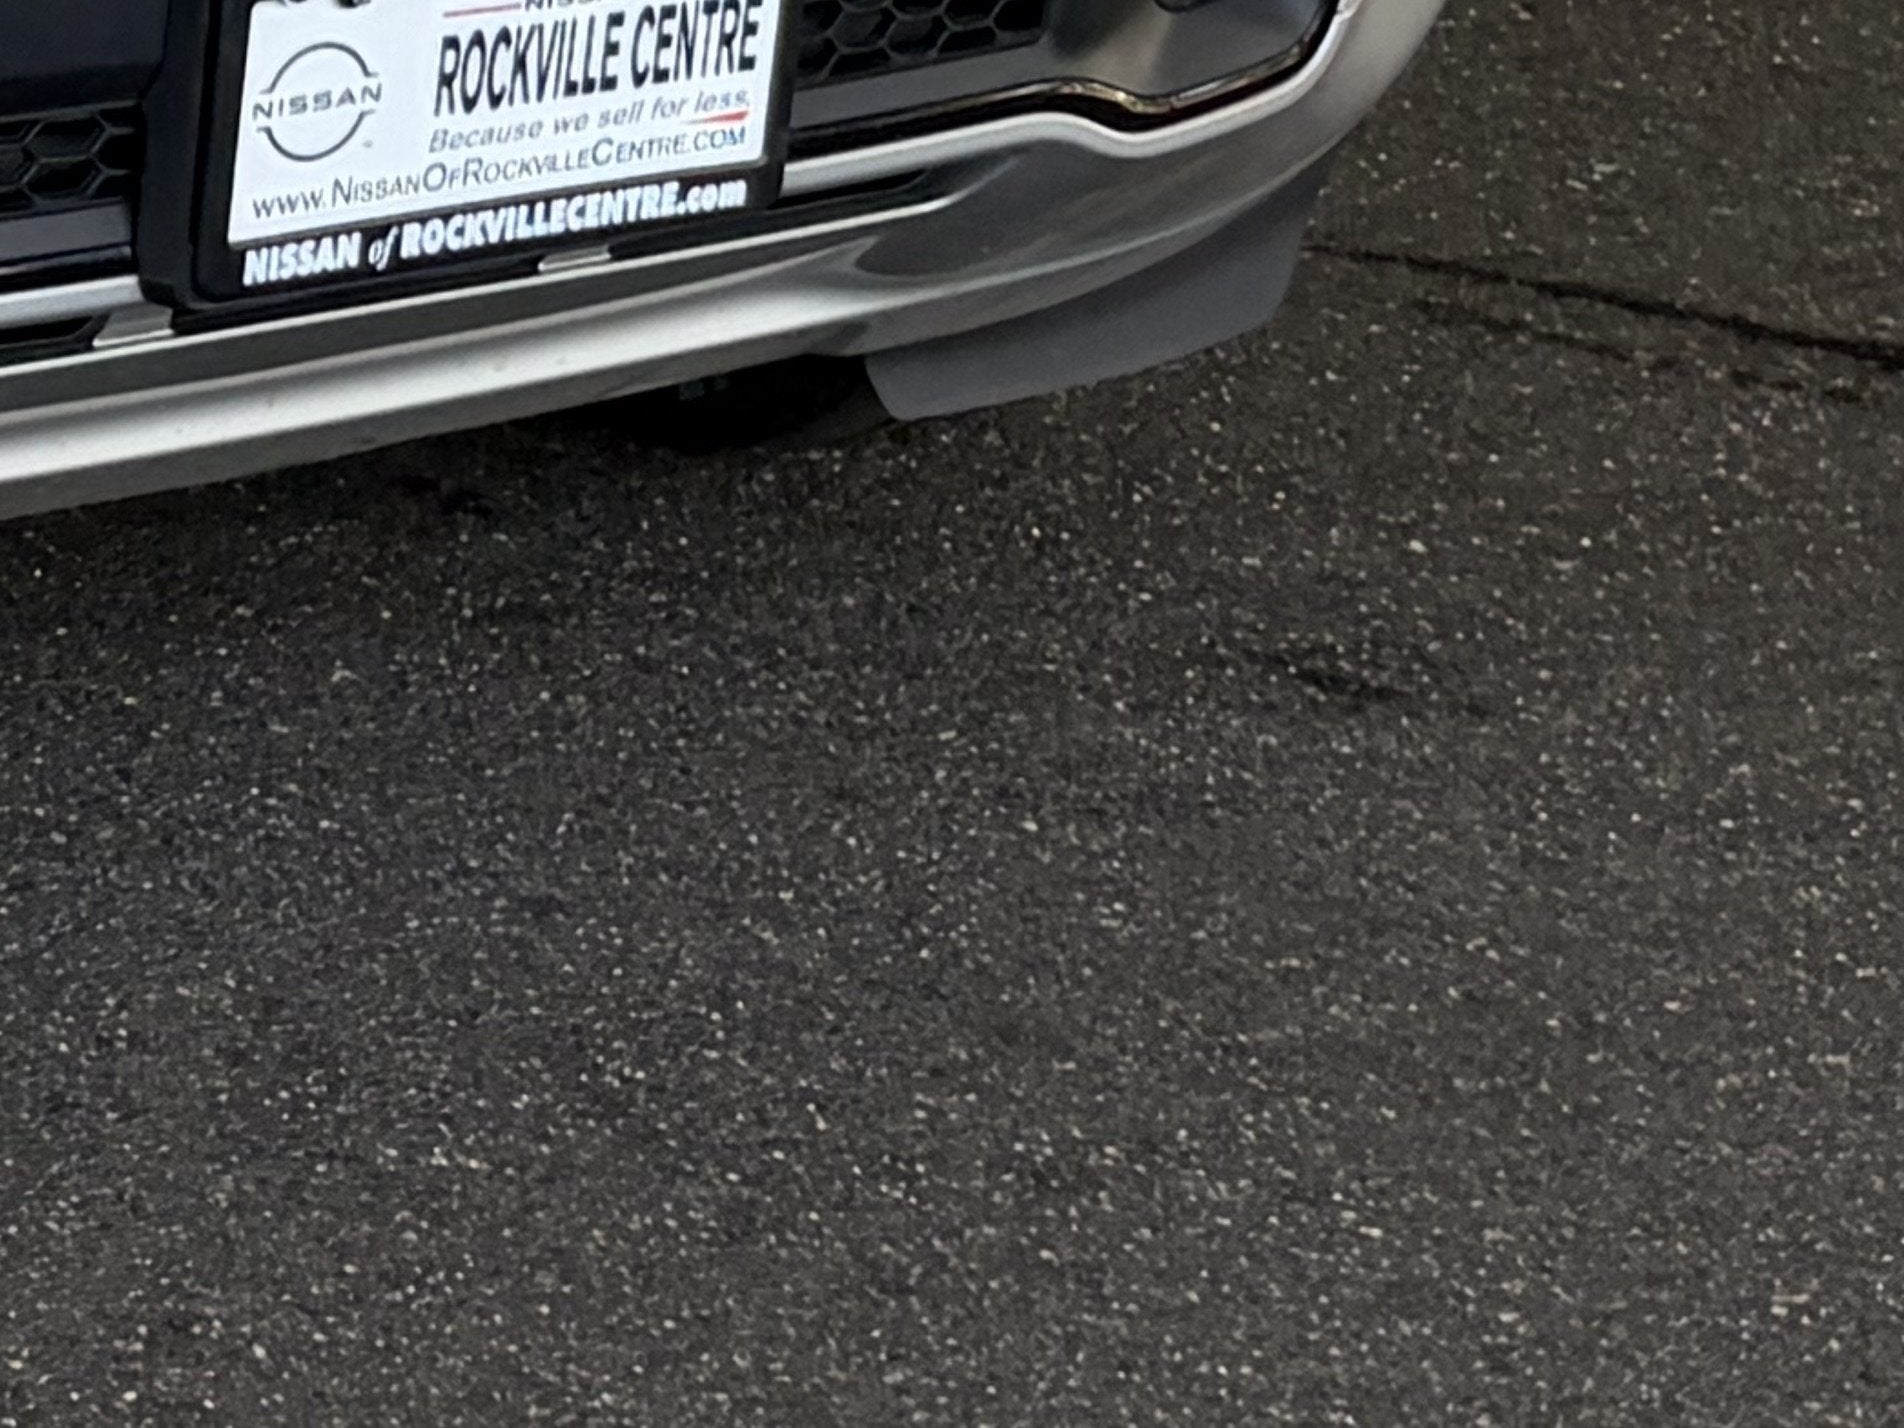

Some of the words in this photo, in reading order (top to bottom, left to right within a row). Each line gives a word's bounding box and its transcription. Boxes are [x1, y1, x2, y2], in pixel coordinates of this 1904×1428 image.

[252, 82, 382, 122] NISSAN
[433, 11, 626, 118] ROCKVILLE
[428, 122, 544, 153] Because
[552, 113, 590, 135] we
[596, 98, 645, 125] sell
[650, 94, 691, 121] for
[243, 230, 362, 286] NISSAN
[368, 225, 399, 272] of
[400, 180, 748, 259] ROCKVILLECENTRE.com
